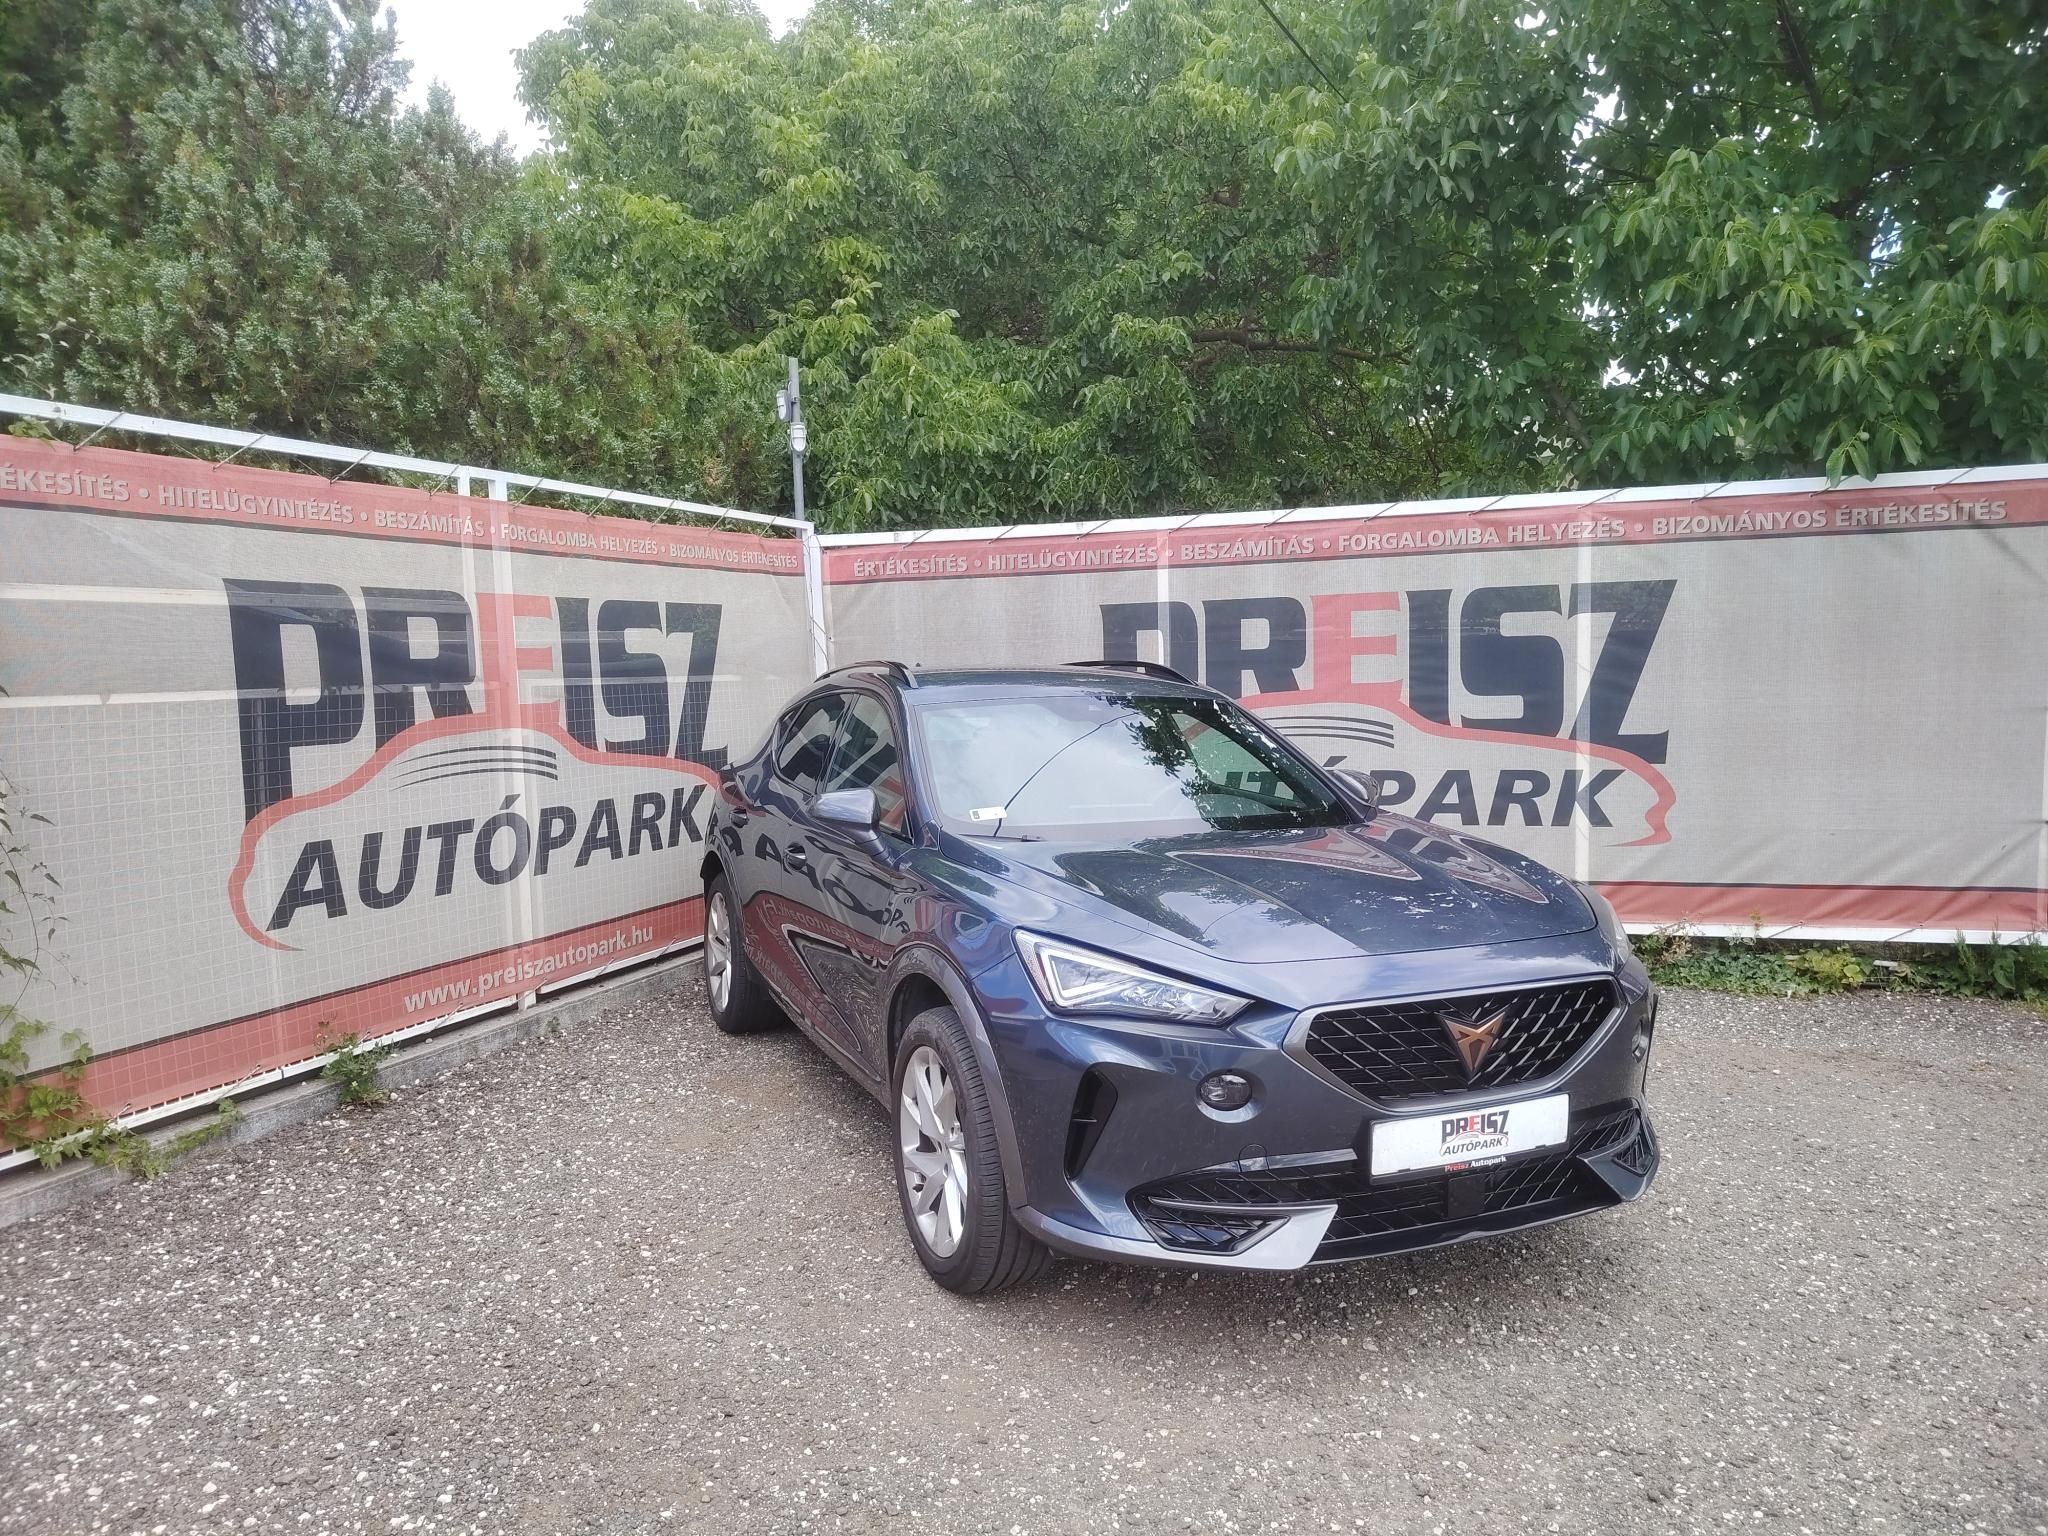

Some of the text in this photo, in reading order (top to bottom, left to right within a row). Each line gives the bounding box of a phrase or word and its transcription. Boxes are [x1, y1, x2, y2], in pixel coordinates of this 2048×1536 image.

[159, 484, 354, 524] HITELÜGYINTÉZÉS
[374, 507, 485, 538] BESZÁMÍTÁS
[501, 522, 597, 549] FORGALOMBA
[600, 535, 658, 556] HELYEZÉS
[669, 543, 739, 564] BIZOMÁNYOS
[853, 499, 2009, 578] ÉRTÉKESÍTÉS HITELÜGYINTÉZÉS BESZÁMÍTÁS FORGALOMBA HELYEZÉS BIZOMÁNYOS ÉRTÉKESÍTÉS
[222, 578, 728, 828] PREISZ
[266, 784, 708, 932] AUTÓPARK
[404, 925, 654, 1013] www.preiszautopark.hu
[1441, 1110, 1509, 1145] PREISZ
[1443, 1136, 1504, 1156] AUTÓPARK
[1470, 1155, 1507, 1168] Autopark
